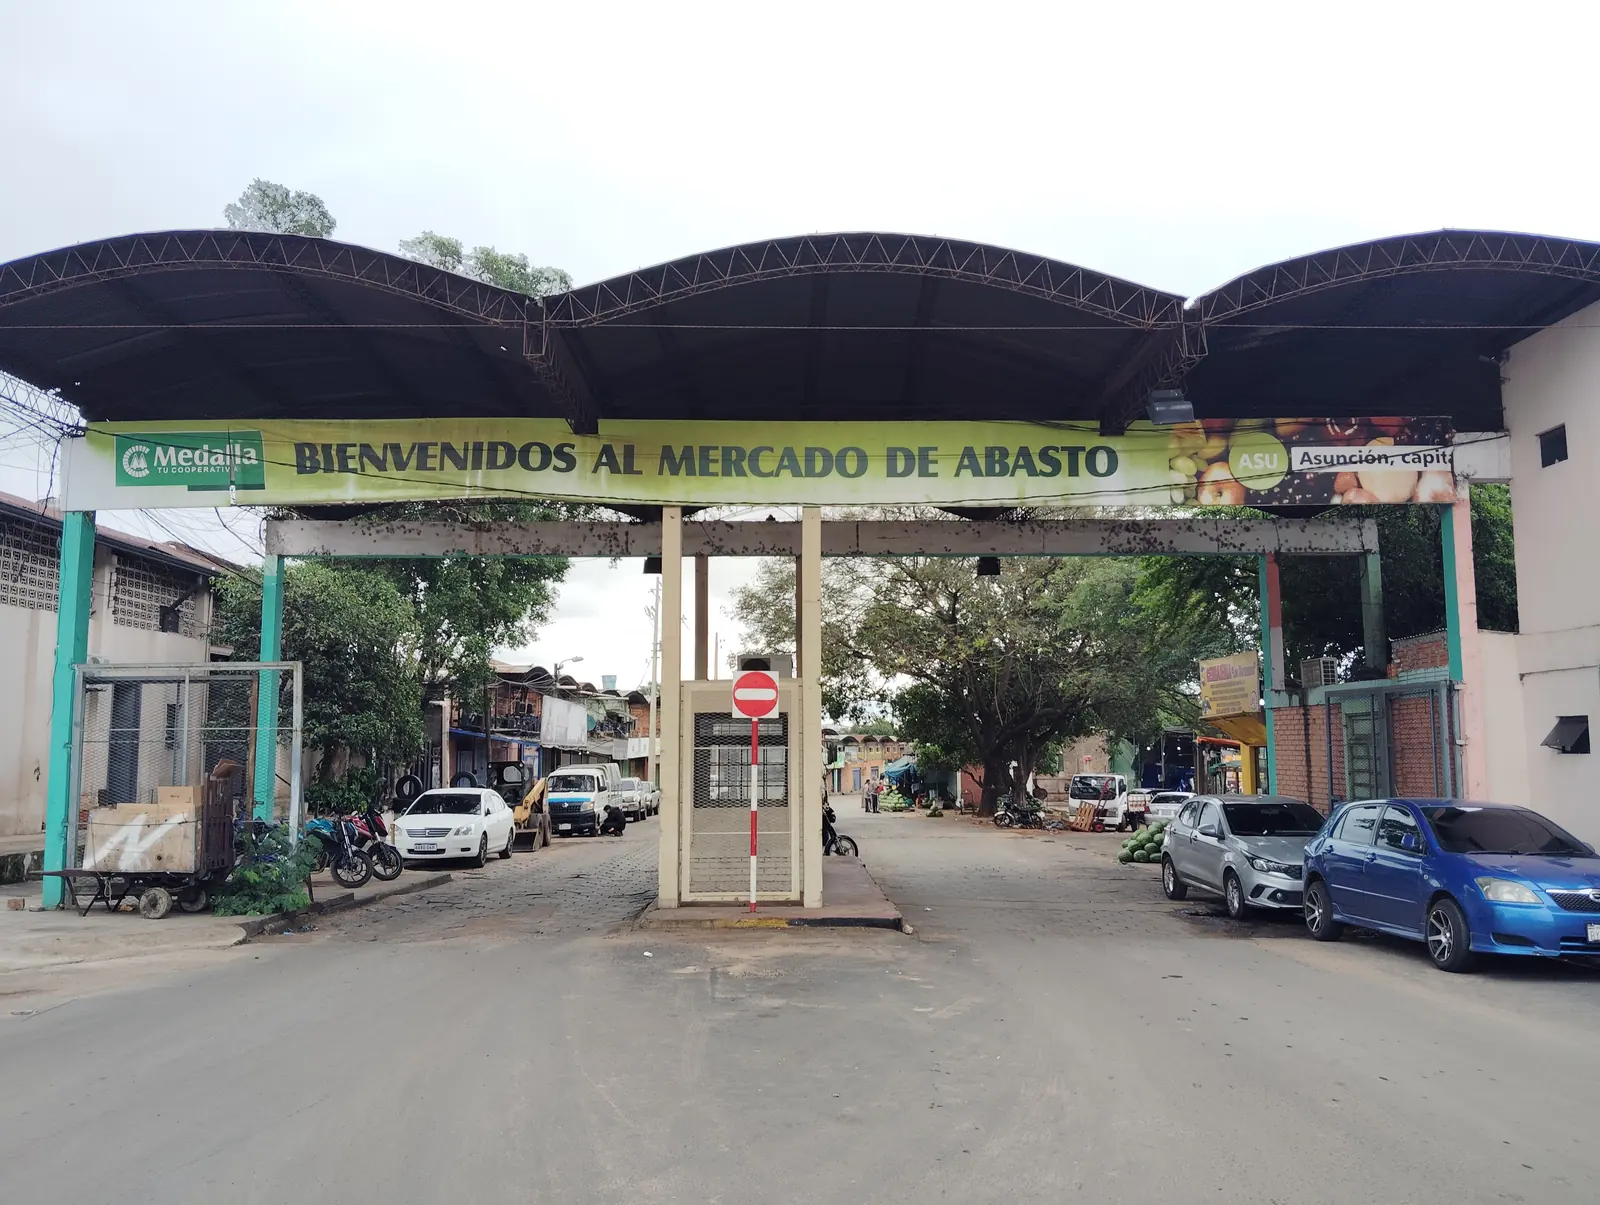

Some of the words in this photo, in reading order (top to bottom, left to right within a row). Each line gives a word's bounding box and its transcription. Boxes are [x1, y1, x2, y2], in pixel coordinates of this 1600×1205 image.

[154, 444, 259, 466] Medalla
[294, 442, 577, 475] BIENVENIDOS
[592, 444, 643, 475] AL
[658, 445, 869, 478] MERCADO
[886, 446, 939, 478] DE
[954, 445, 1119, 477] ABASTO
[1238, 453, 1279, 470] ASU
[1300, 450, 1394, 466] Asunción,
